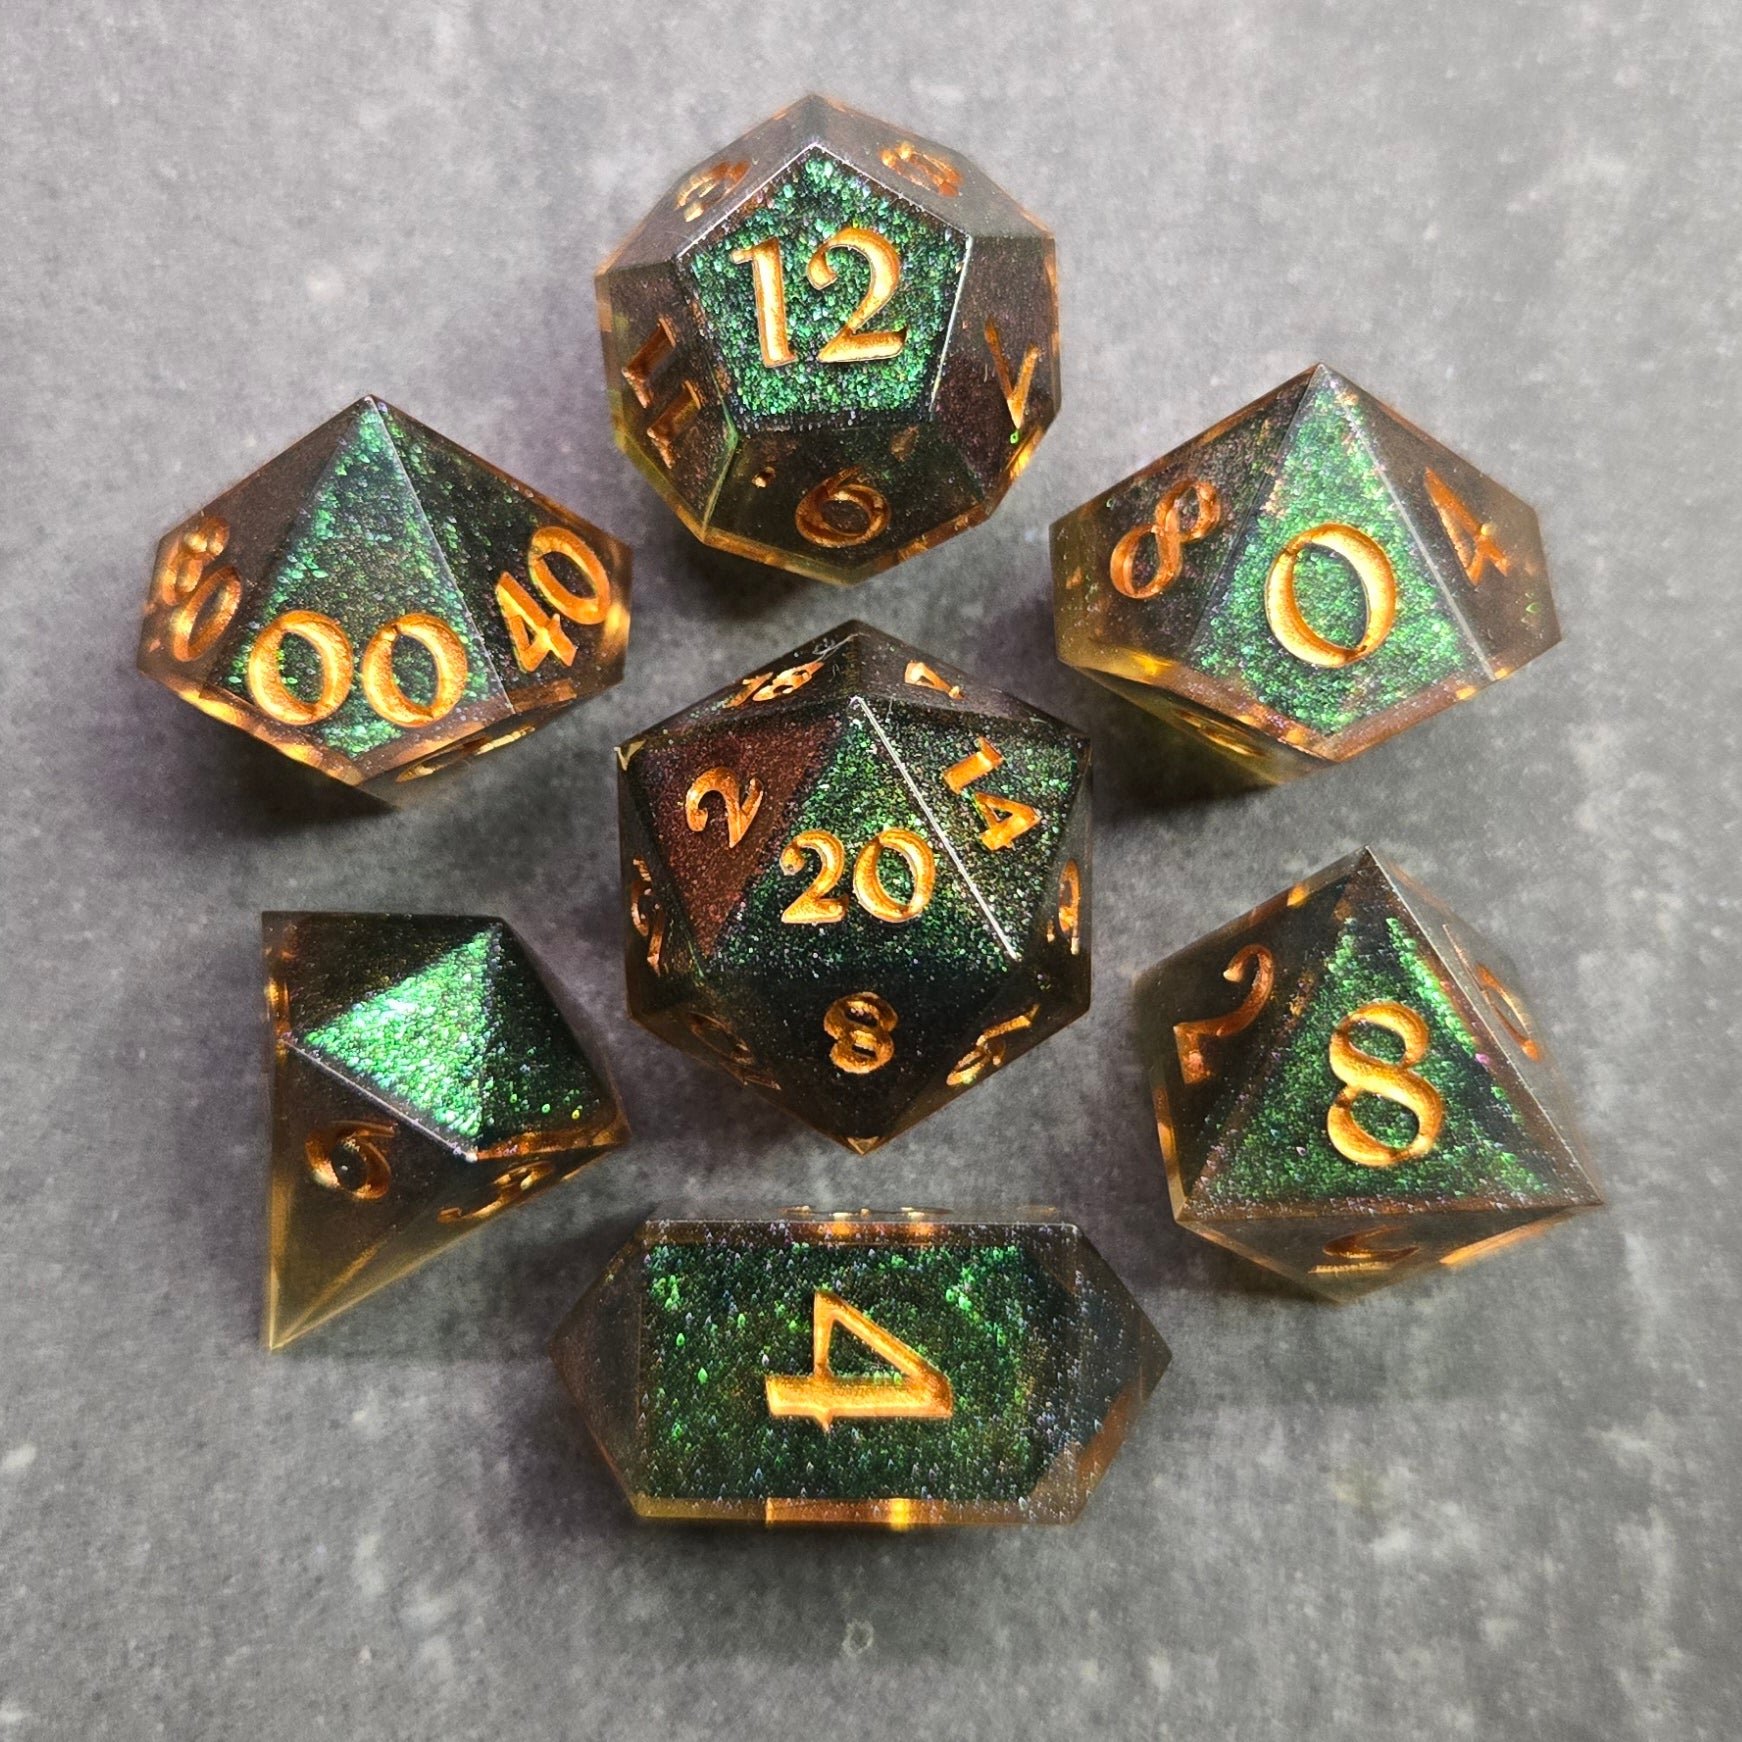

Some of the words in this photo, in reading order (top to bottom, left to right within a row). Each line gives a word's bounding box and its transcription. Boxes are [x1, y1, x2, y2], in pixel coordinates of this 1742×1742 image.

[731, 227, 909, 368] 12
[1110, 478, 1221, 599] 8
[1424, 467, 1508, 586] 4
[496, 525, 611, 674] 40
[1265, 523, 1397, 668] 0
[247, 610, 469, 728] 00
[685, 766, 764, 849] 2
[942, 735, 1041, 851] 14
[780, 828, 935, 924] 20
[823, 991, 898, 1074] 8
[1173, 943, 1275, 1085] 2
[1326, 1000, 1444, 1168] 8
[765, 1289, 954, 1433] 4
